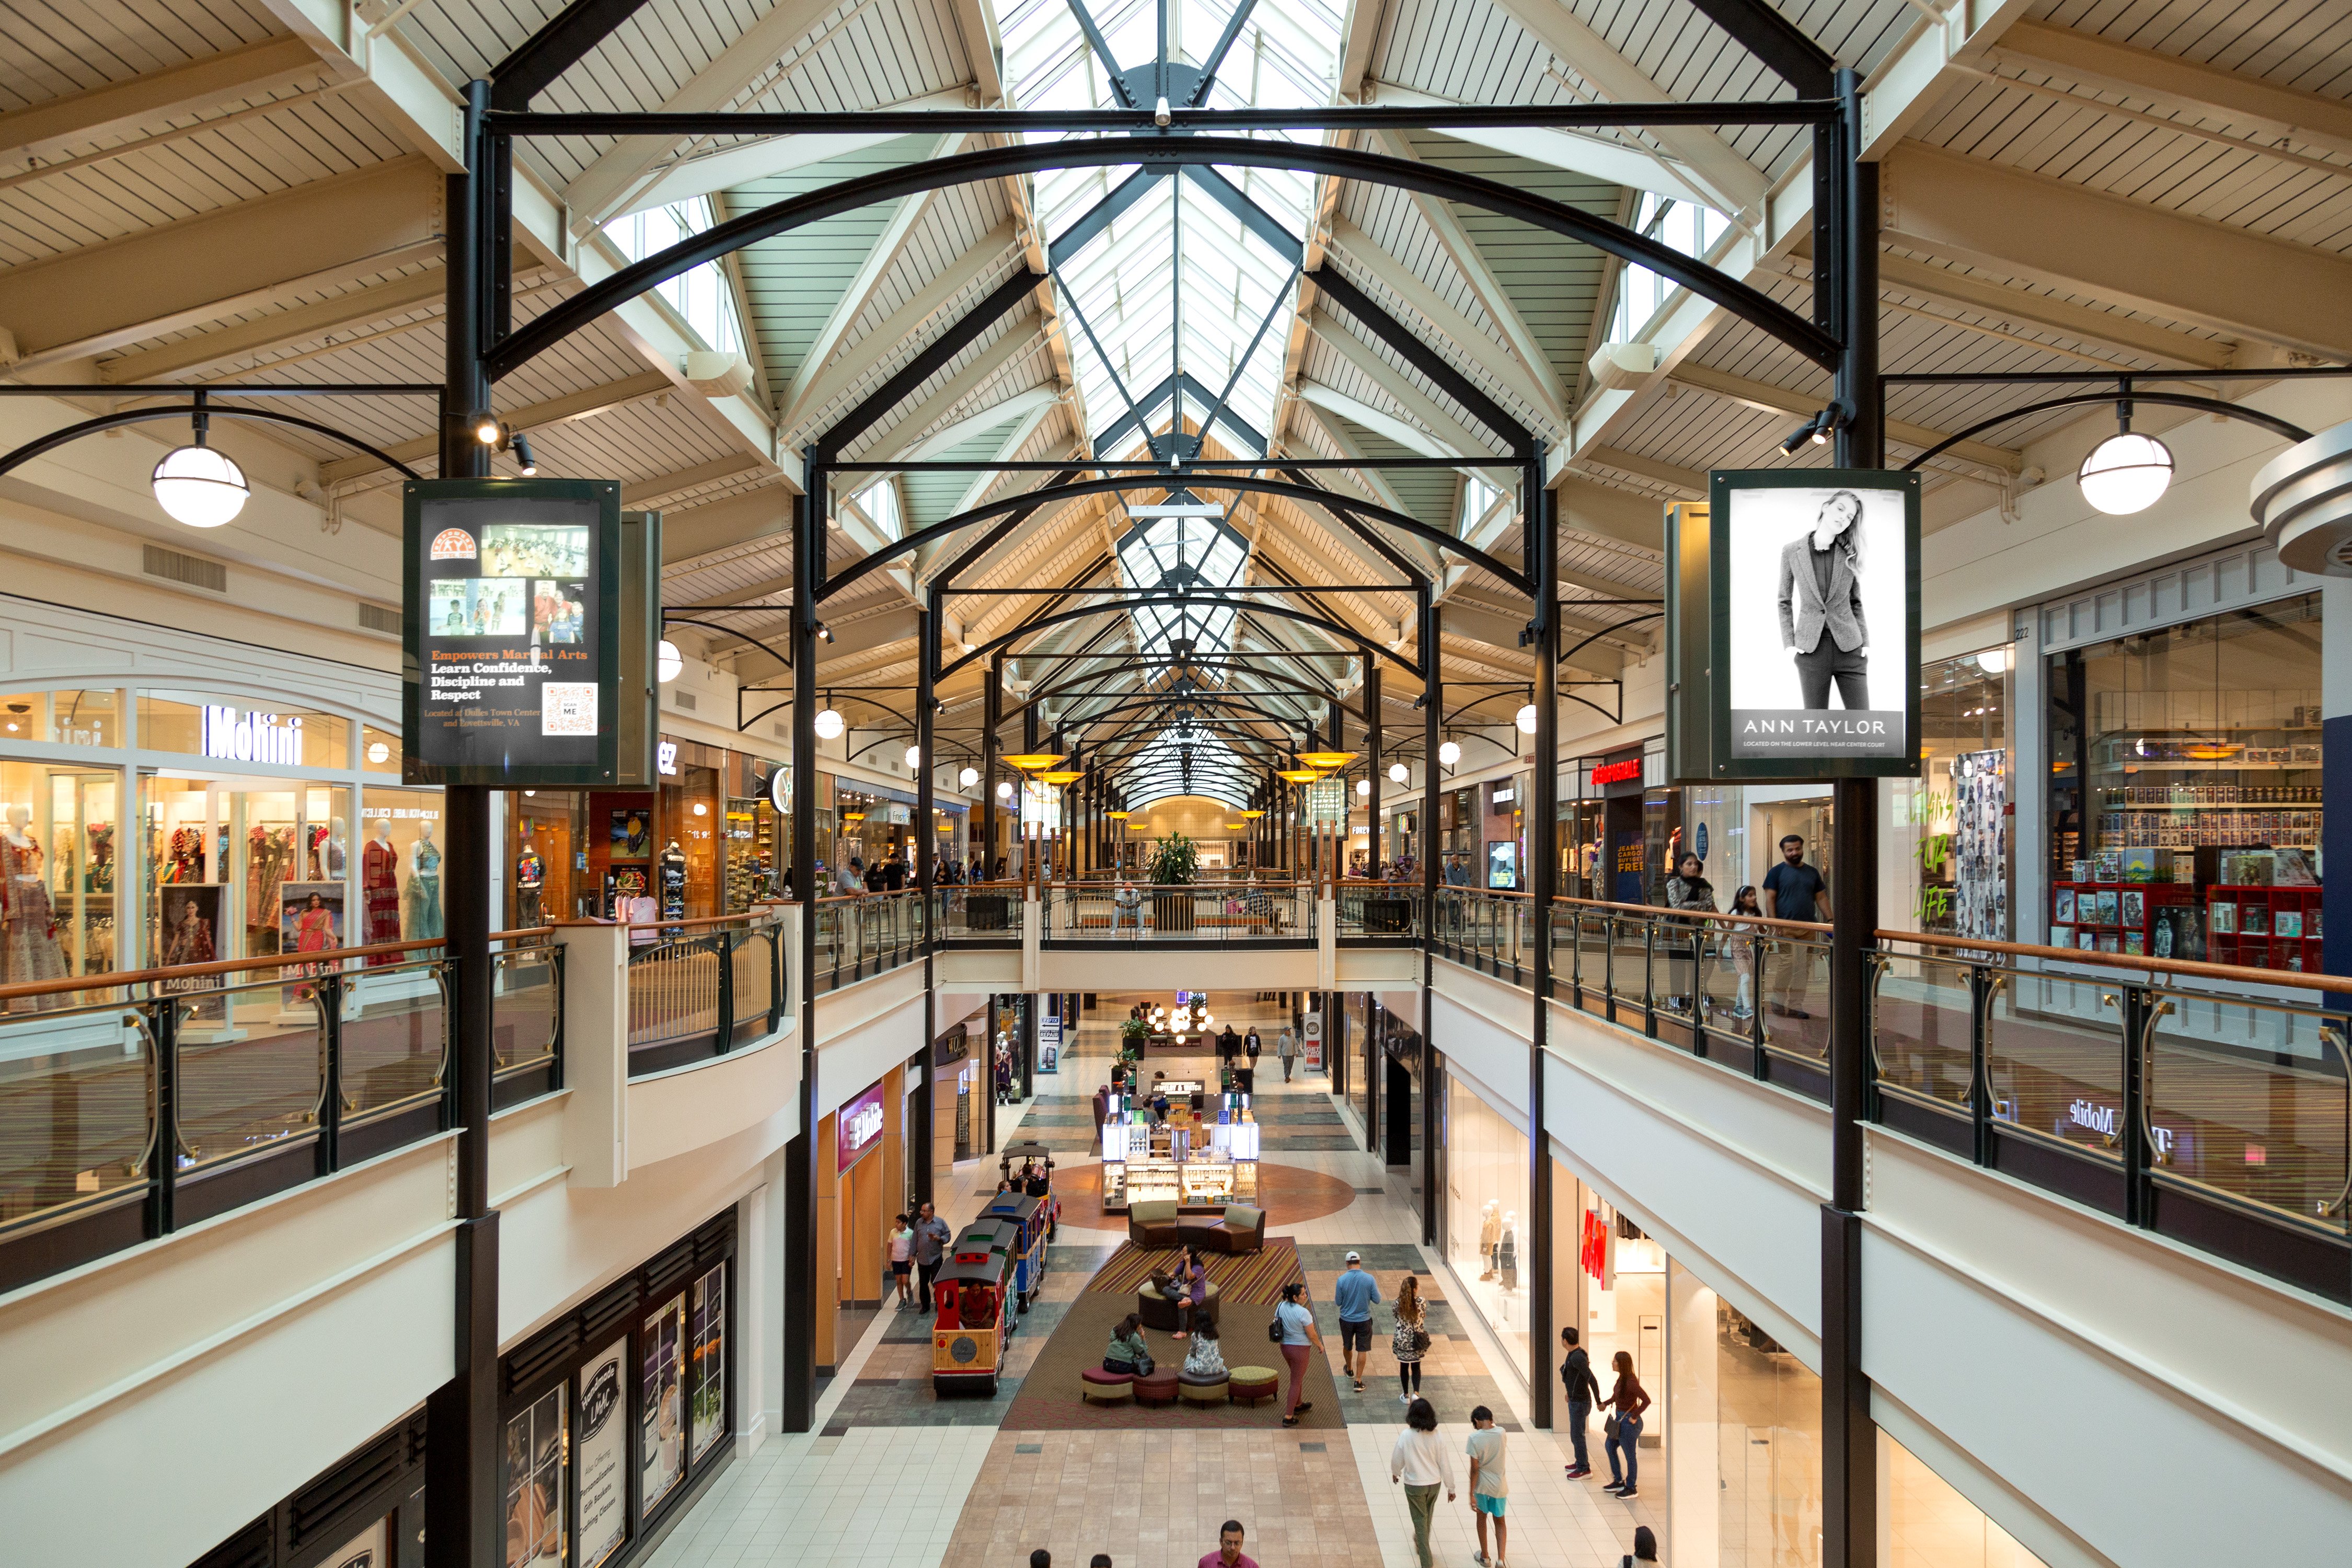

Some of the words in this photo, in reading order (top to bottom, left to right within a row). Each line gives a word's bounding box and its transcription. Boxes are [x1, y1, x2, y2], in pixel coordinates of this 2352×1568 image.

[2015, 627, 2028, 640] 222
[432, 650, 499, 663] Empowers
[502, 650, 553, 660] Maral
[558, 650, 587, 660] Arts
[431, 663, 470, 673] Learn
[473, 662, 552, 674] Confidence,
[431, 676, 496, 689] Discipline
[499, 676, 525, 686] and
[431, 690, 481, 702] Respect
[460, 719, 505, 727] Lovettsville,
[1744, 720, 1794, 733] ANN
[1802, 720, 1886, 734] TAYLOR
[203, 705, 302, 765] Mohini
[1352, 826, 1369, 834] FOREV
[1913, 833, 1947, 873] FOR
[1618, 862, 1644, 872] FREE
[1913, 884, 1949, 923] LIFE
[166, 975, 220, 989] Mohini
[581, 1364, 615, 1411] Handmade
[584, 1464, 594, 1477] Also
[584, 1499, 593, 1514] Gift
[594, 1483, 612, 1504] Baskets
[599, 1496, 616, 1516] Classes
